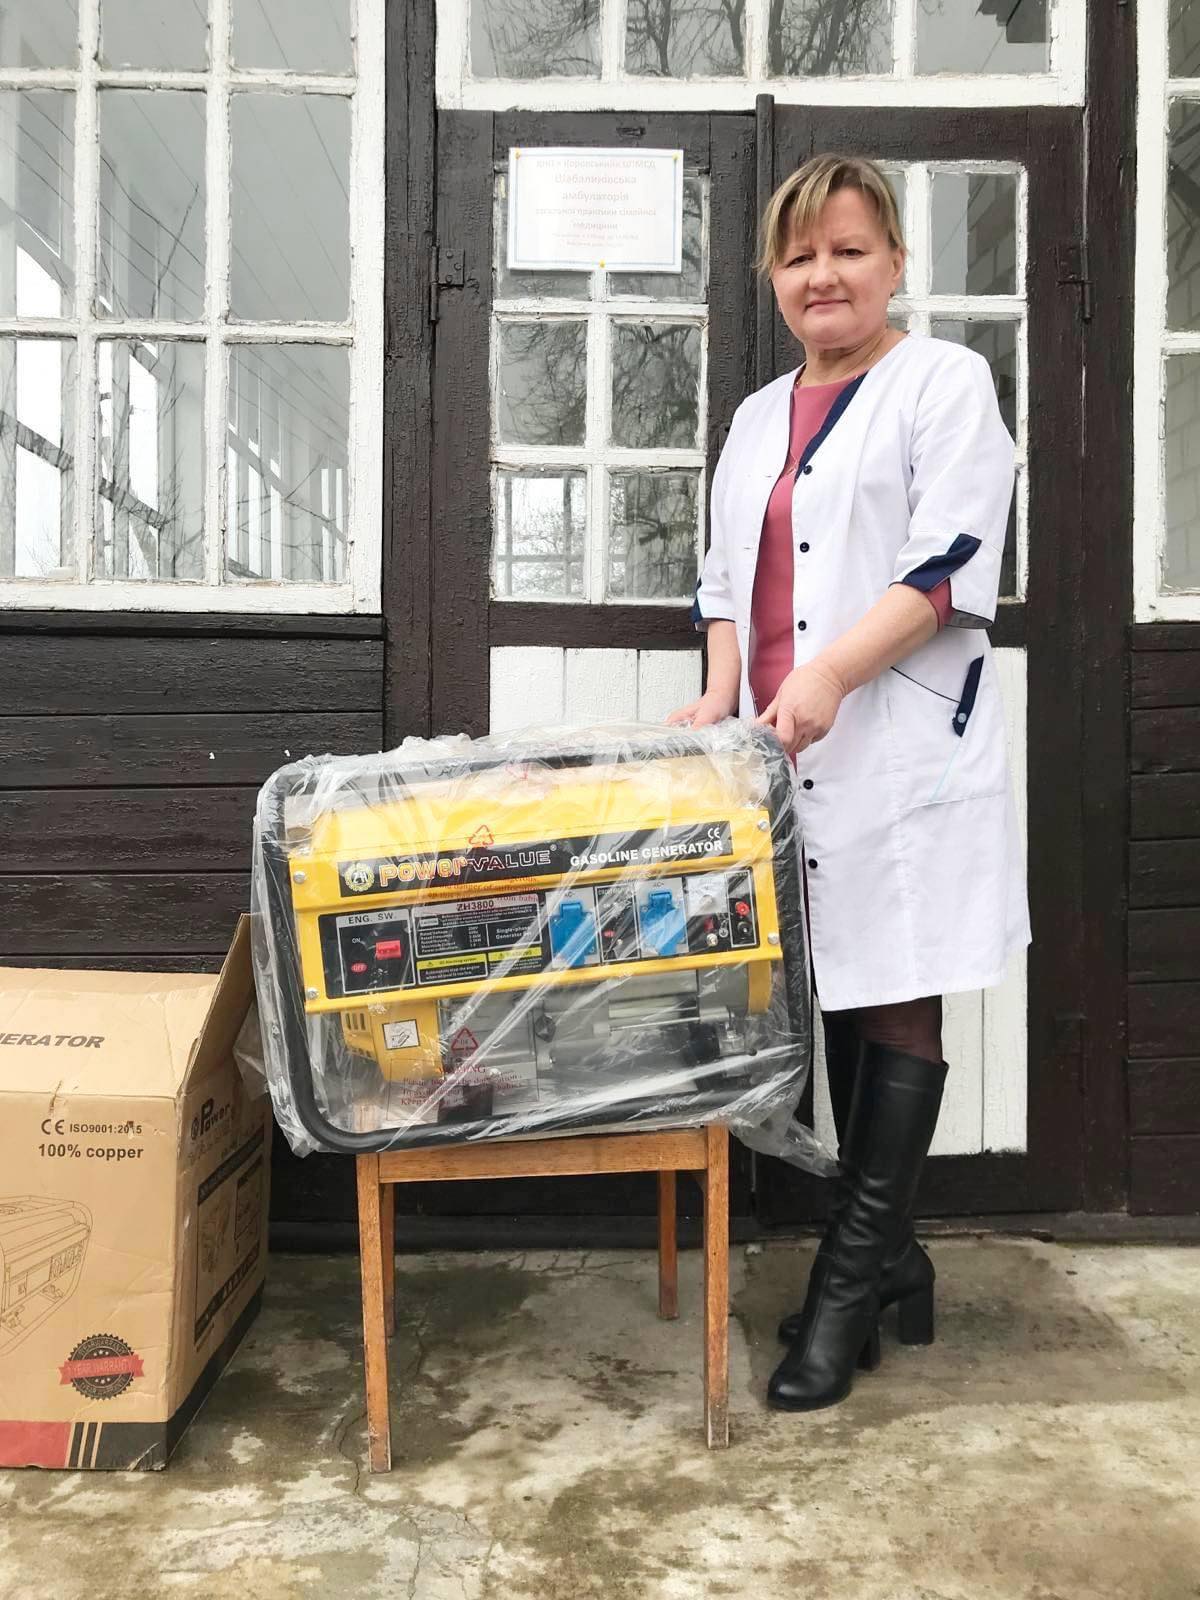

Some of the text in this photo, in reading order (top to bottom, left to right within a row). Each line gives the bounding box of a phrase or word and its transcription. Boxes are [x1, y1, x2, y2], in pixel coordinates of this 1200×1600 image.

[570, 840, 723, 867] GASOLINE GENERATOR
[456, 900, 495, 912] ZH3800
[348, 915, 373, 924] ENG.
[41, 1119, 65, 1135] CE
[38, 1144, 144, 1161] 100% copper
